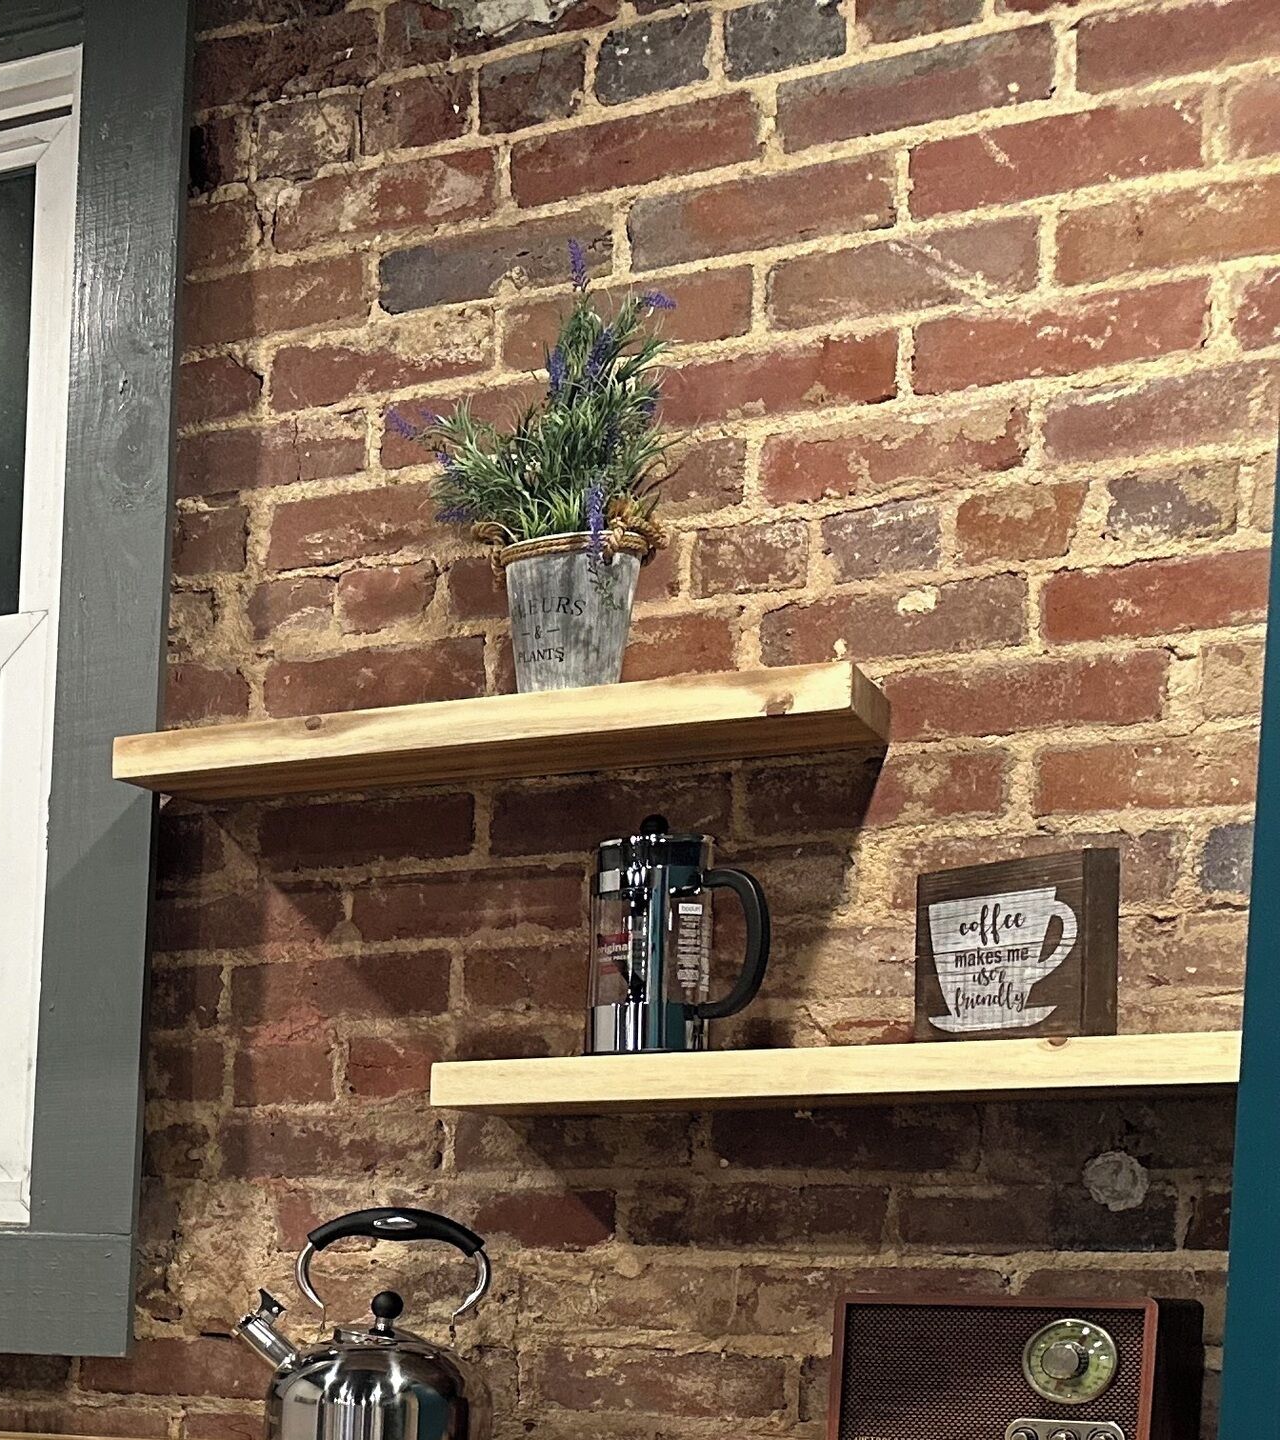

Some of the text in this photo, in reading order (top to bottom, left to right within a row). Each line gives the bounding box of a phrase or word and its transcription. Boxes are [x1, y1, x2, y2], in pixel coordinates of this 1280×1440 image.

[517, 647, 565, 663] PLANTS
[959, 903, 1026, 946] coffee
[954, 946, 1029, 968] makes me
[972, 968, 1005, 986] user
[954, 982, 1024, 1017] friendly
